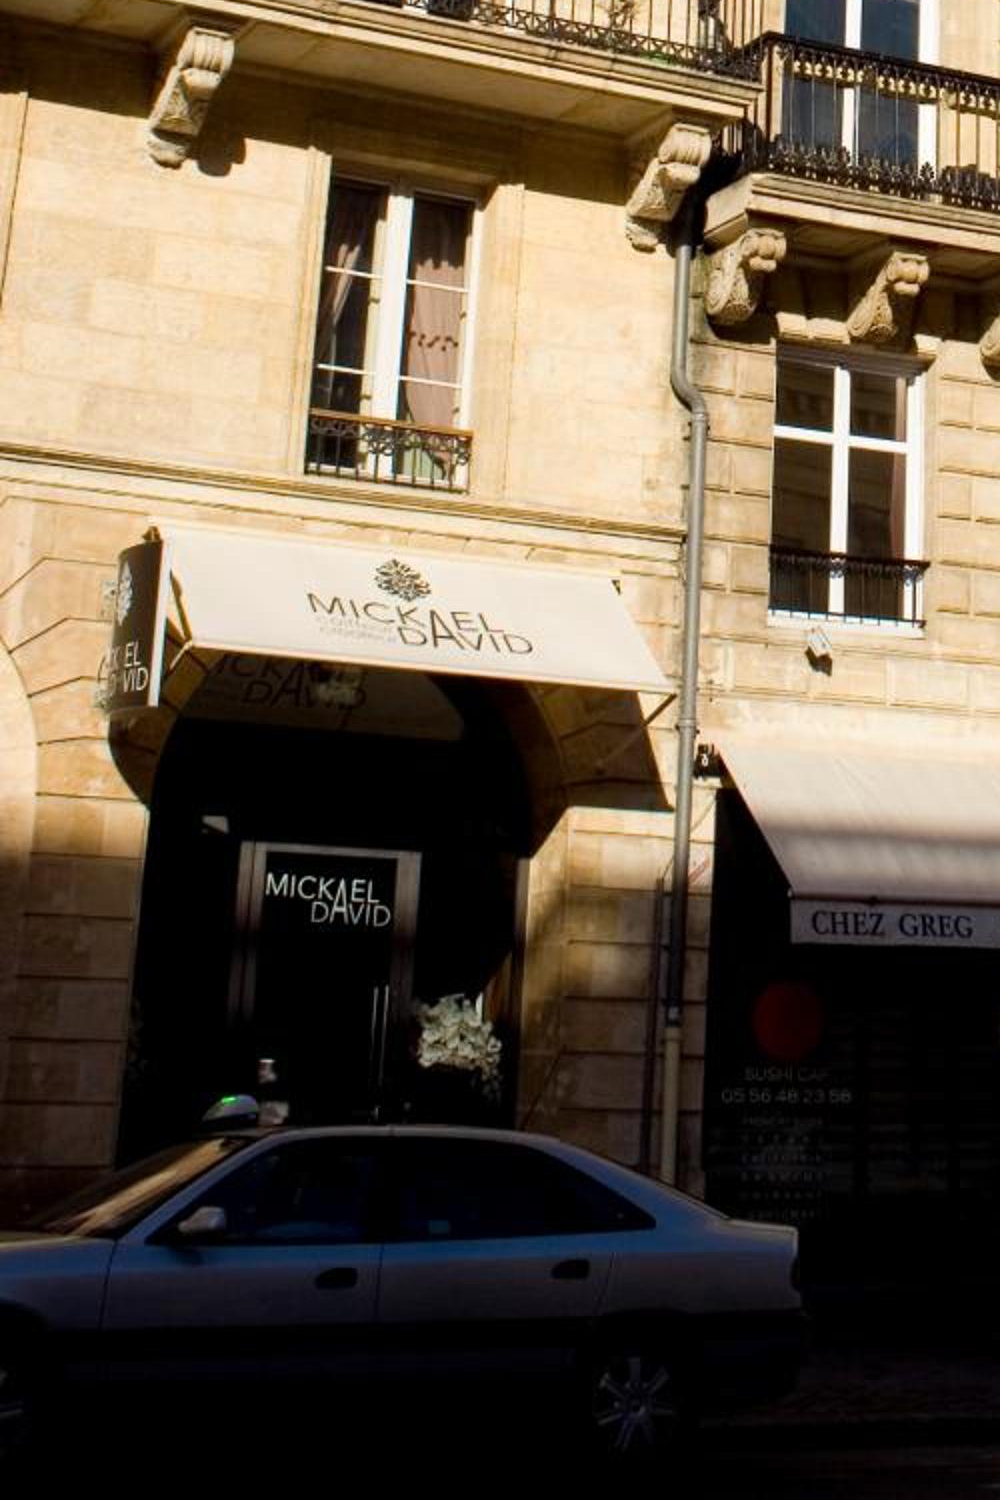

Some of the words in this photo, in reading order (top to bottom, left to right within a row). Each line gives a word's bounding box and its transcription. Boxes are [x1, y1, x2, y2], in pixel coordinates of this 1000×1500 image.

[307, 593, 504, 638] MICKAEL
[397, 614, 533, 654] DAVID
[266, 872, 380, 910] MICKAEL
[311, 895, 391, 928] DAVID
[811, 910, 885, 937] CHEZ
[898, 913, 974, 939] GREG
